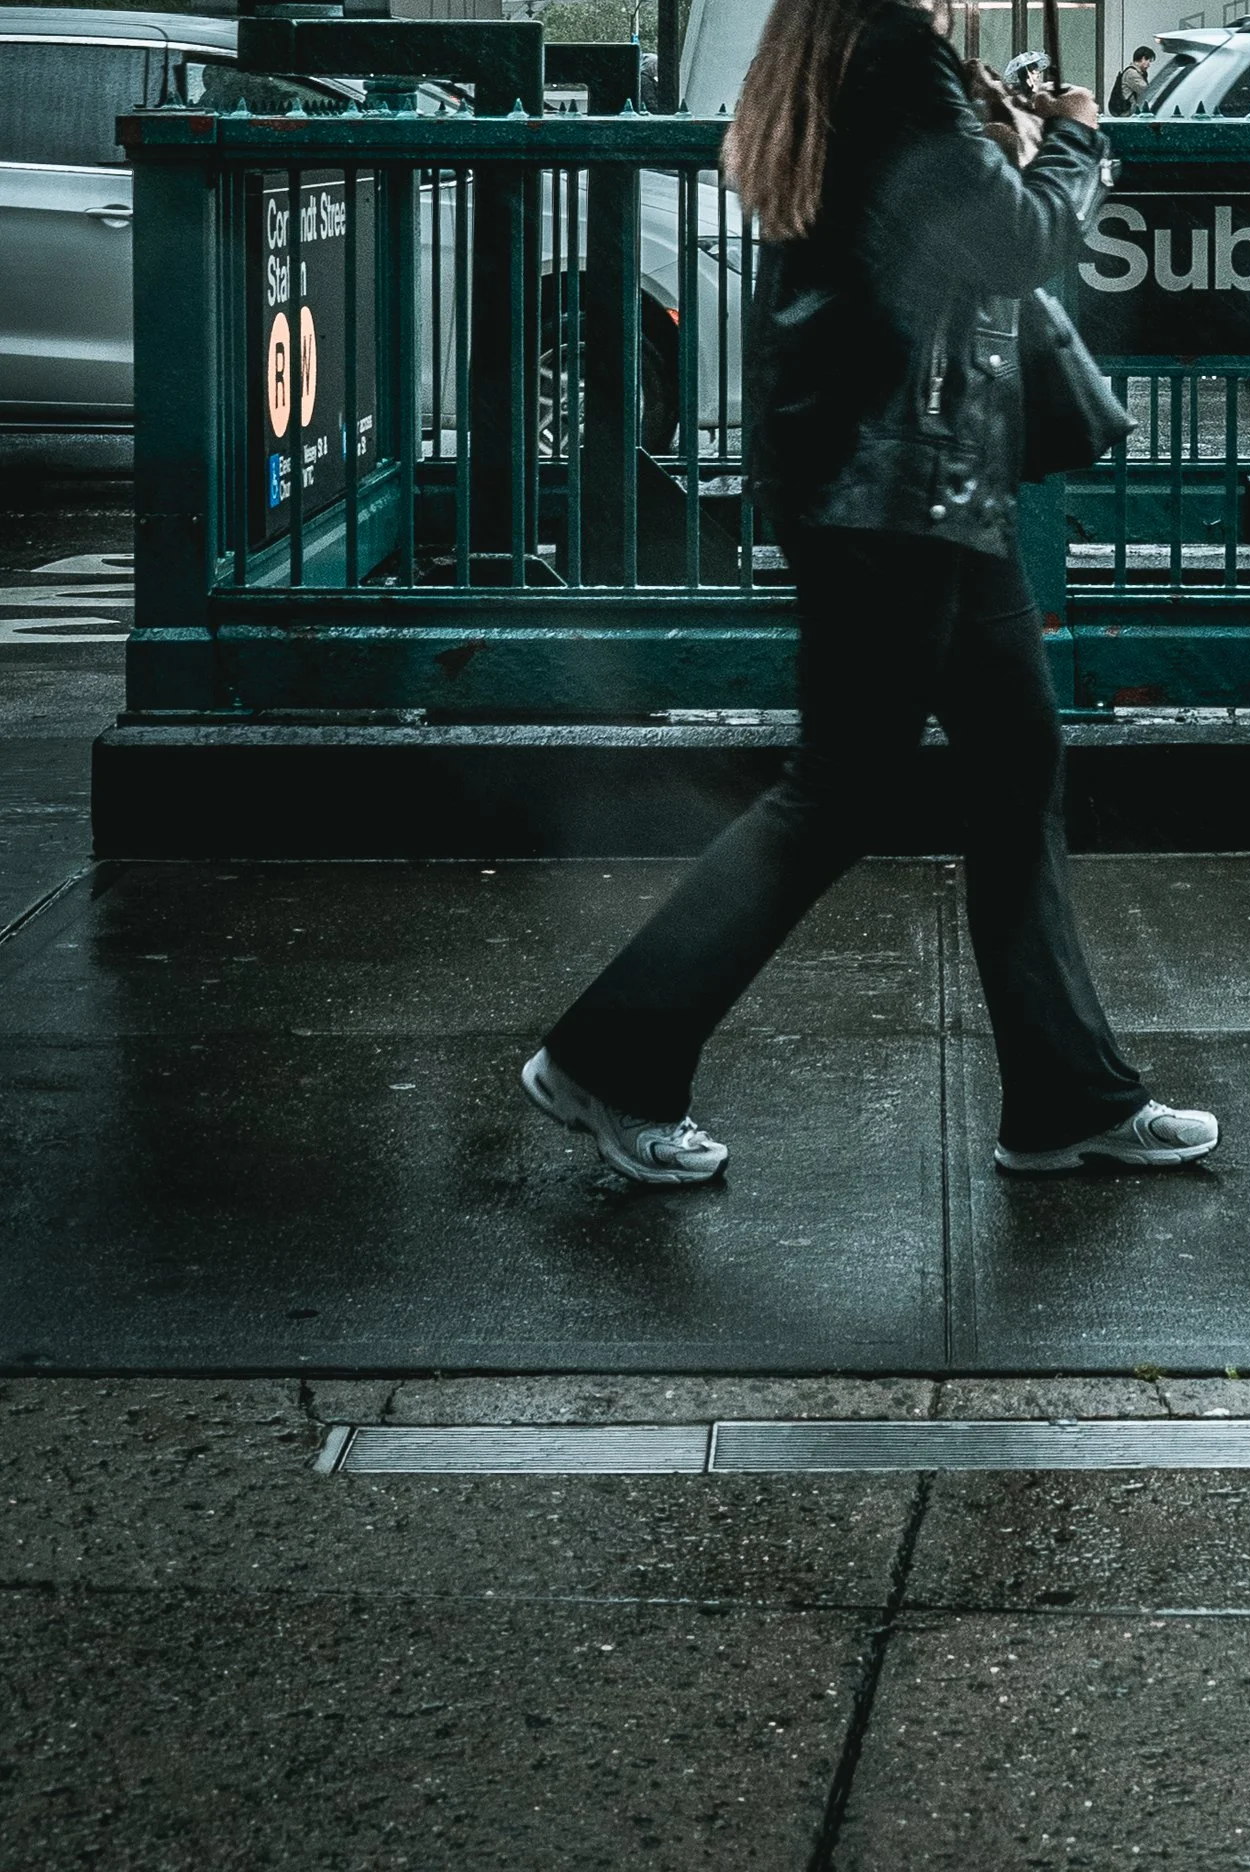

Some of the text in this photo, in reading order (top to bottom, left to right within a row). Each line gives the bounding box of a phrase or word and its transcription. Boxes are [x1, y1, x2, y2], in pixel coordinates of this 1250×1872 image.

[267, 191, 347, 250] Corndt Stree
[275, 341, 286, 409] R
